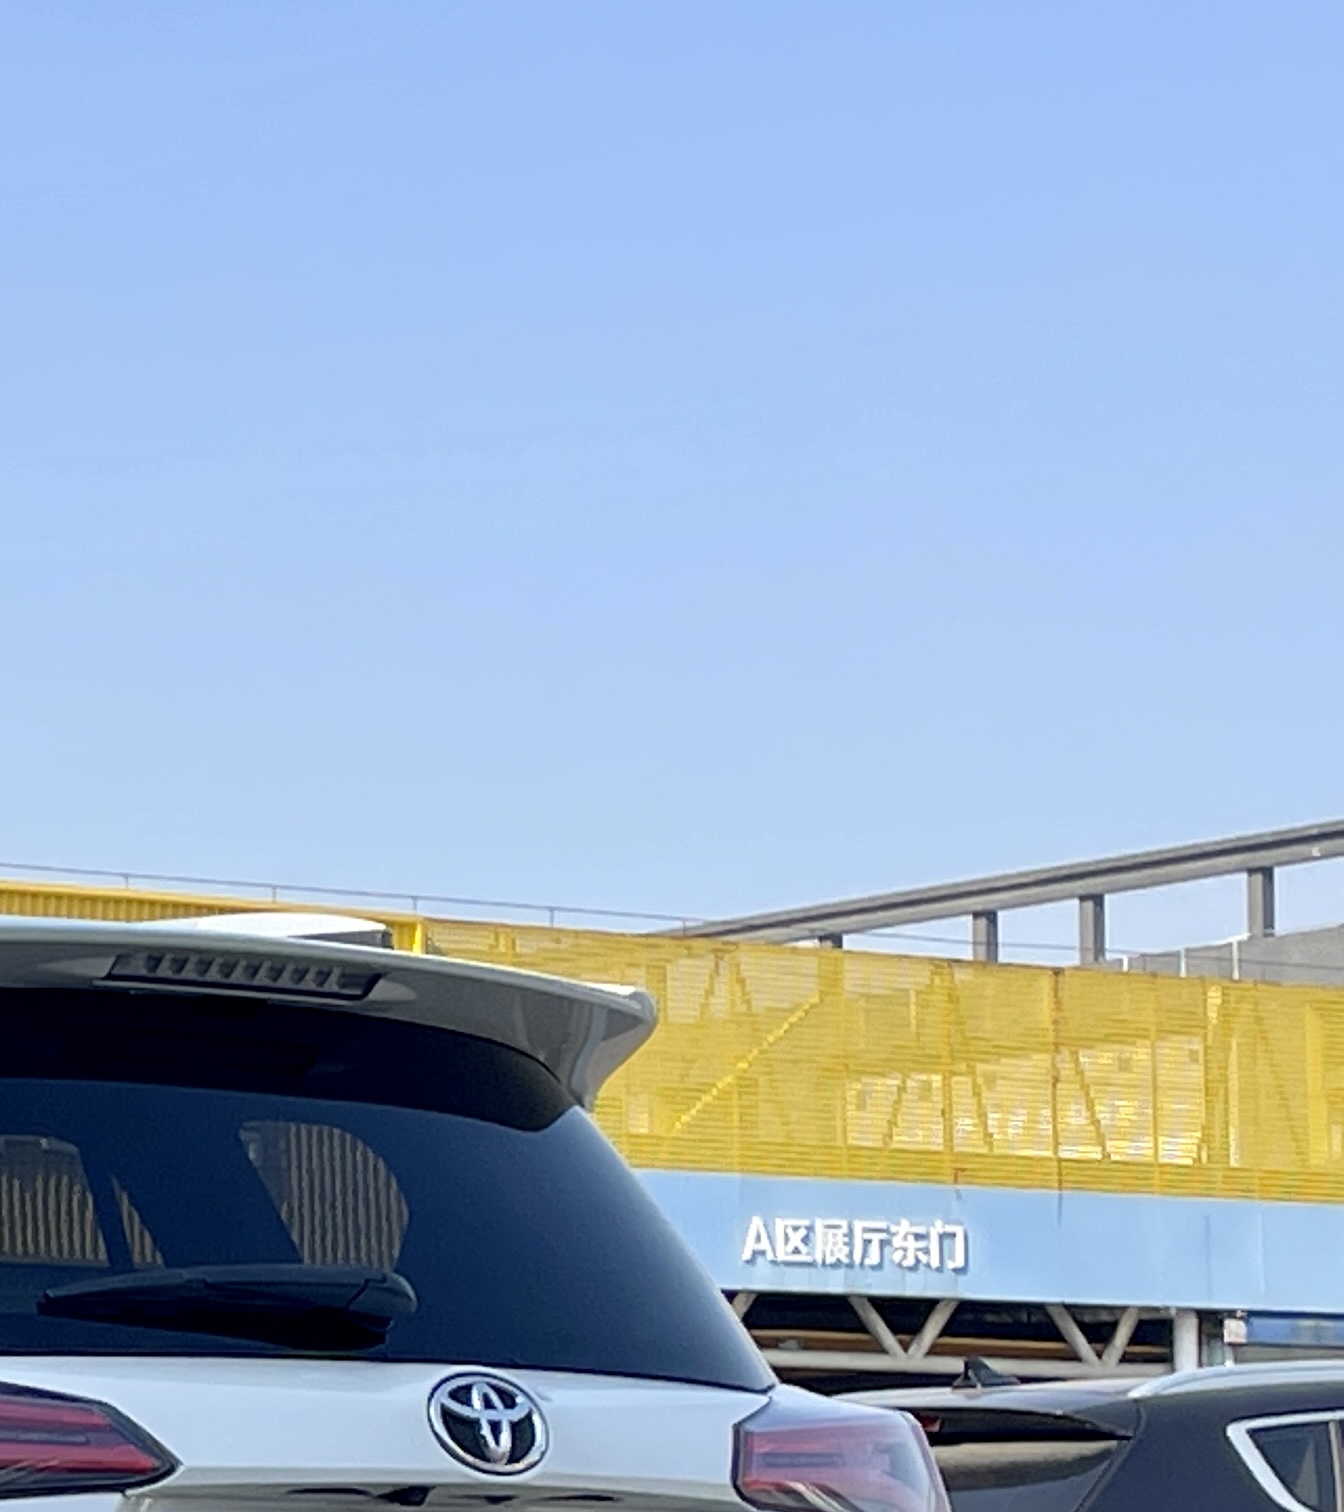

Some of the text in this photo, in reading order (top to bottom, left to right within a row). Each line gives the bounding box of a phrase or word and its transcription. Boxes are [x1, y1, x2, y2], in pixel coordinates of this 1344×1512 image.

[740, 1214, 968, 1271] A区展厅东门
